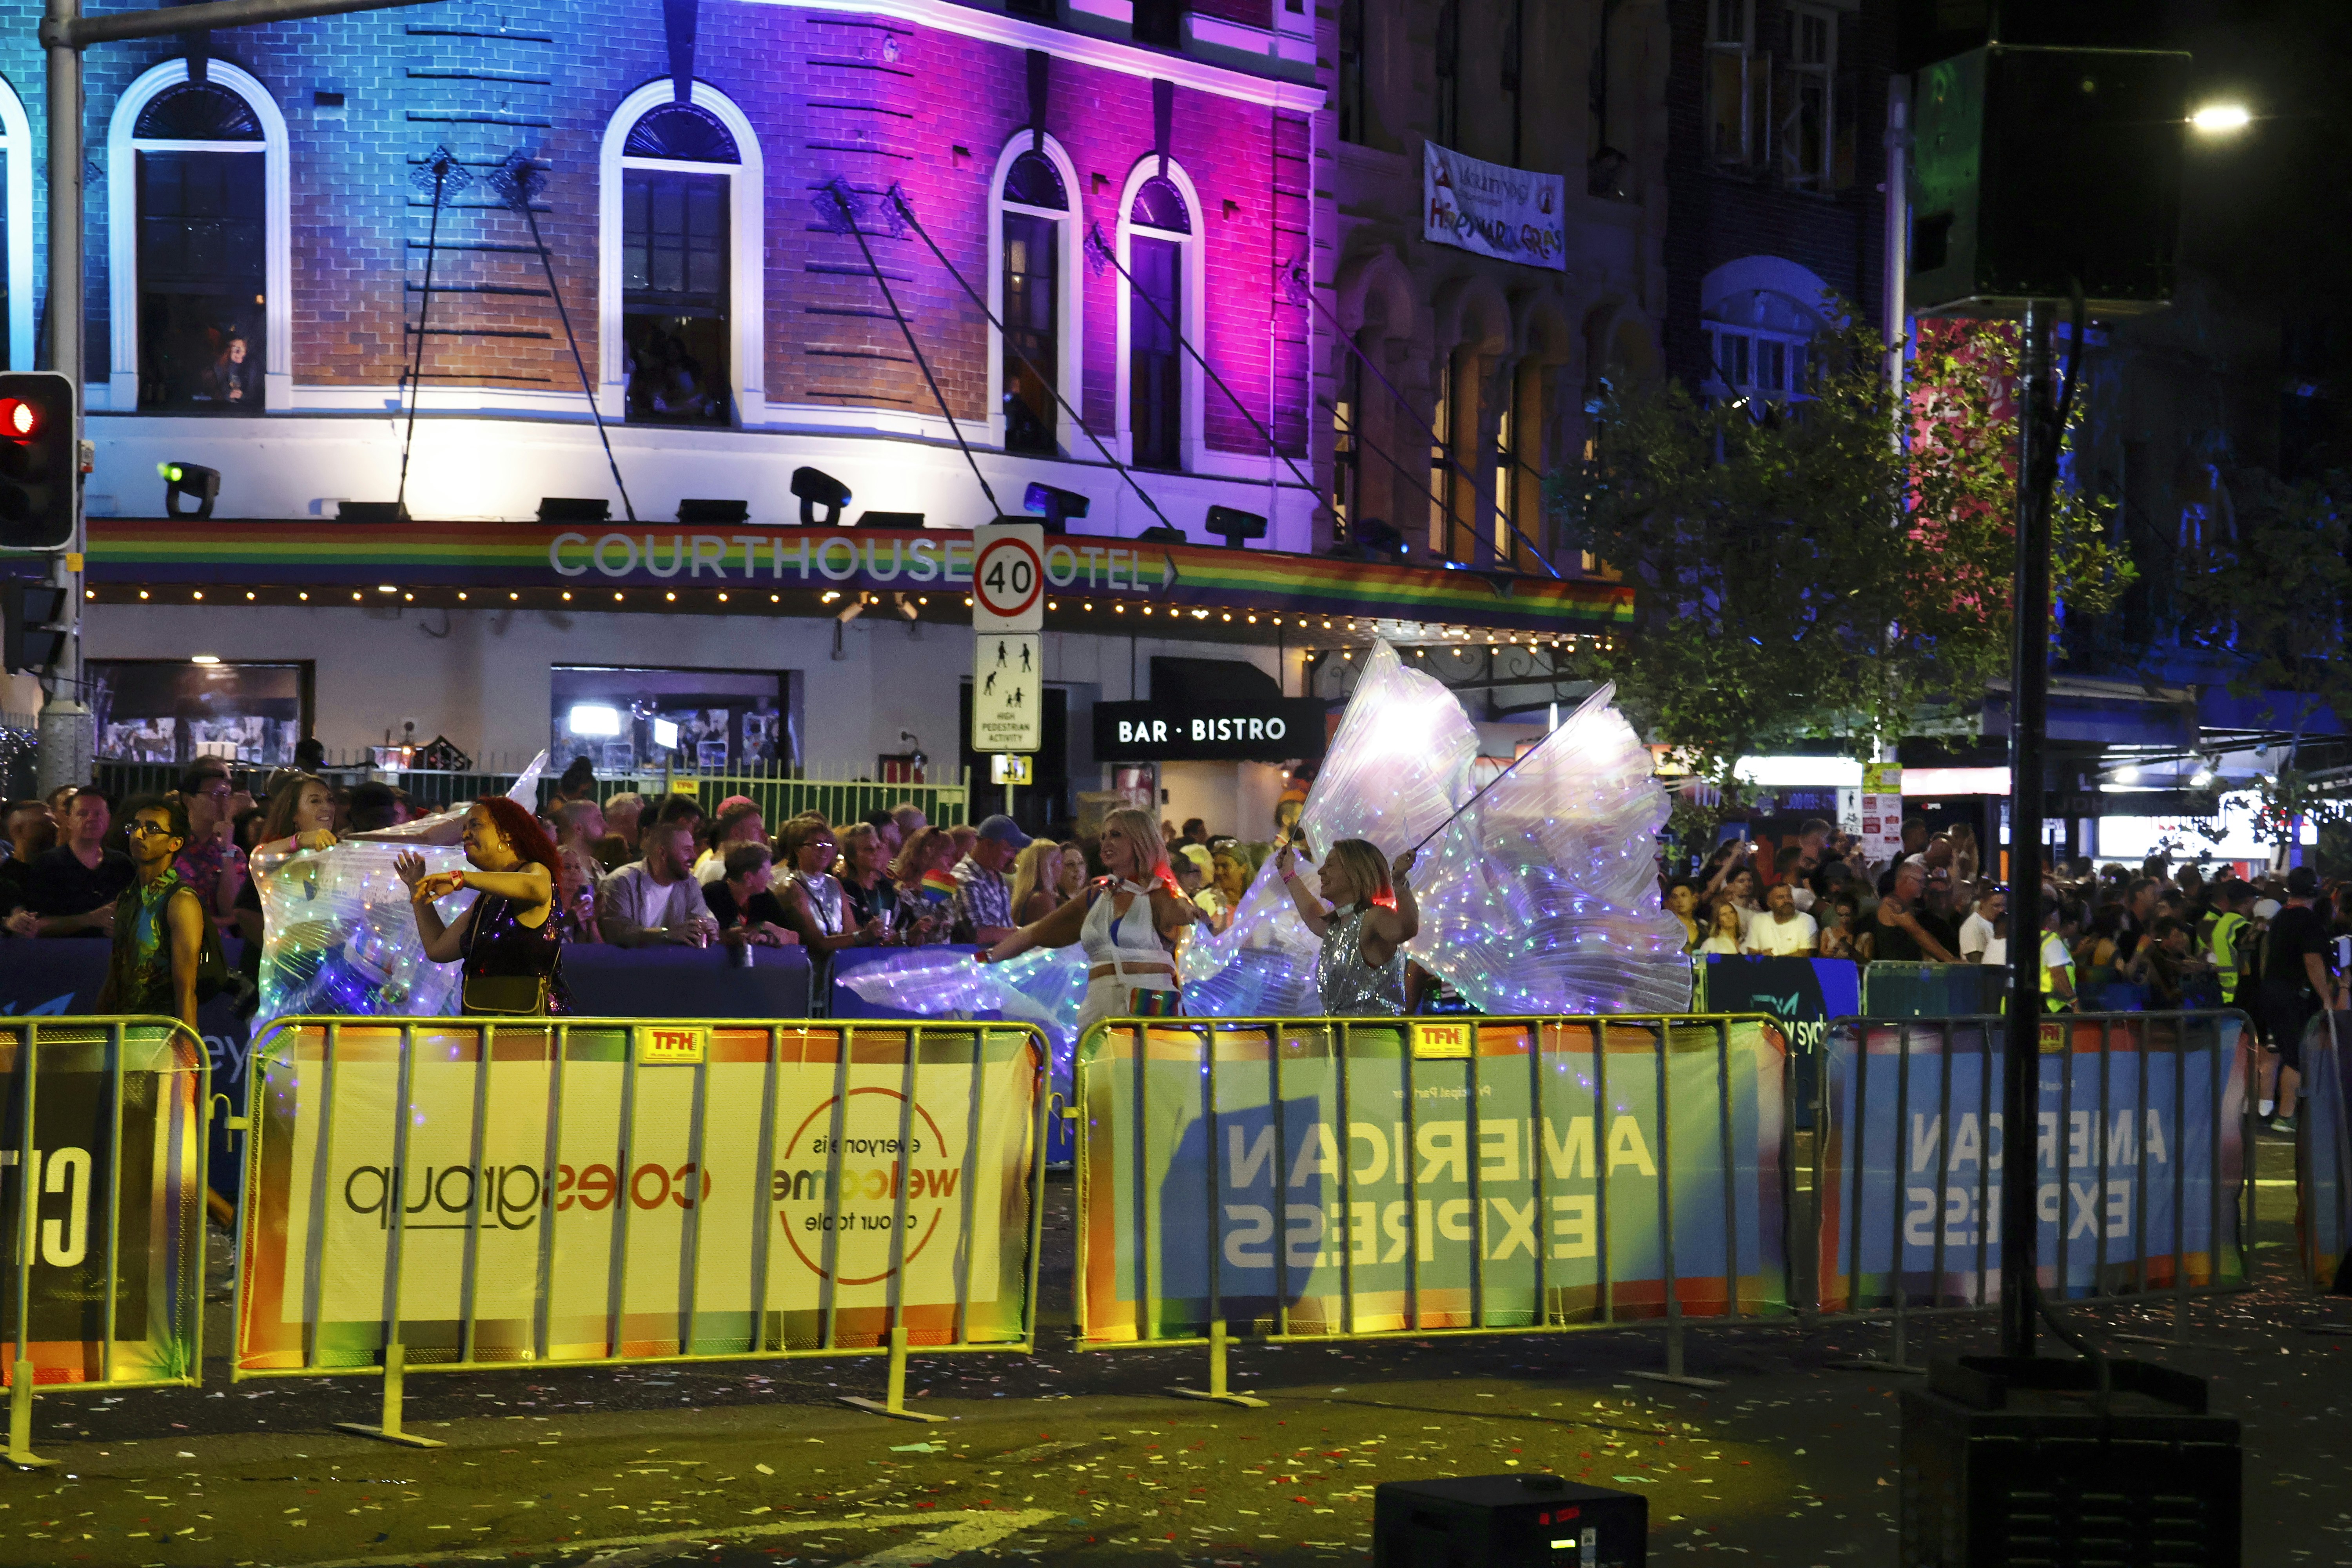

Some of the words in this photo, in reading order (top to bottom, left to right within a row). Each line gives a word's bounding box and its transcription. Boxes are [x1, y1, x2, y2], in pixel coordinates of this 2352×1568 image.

[549, 532, 973, 582] COURTHOUSE
[1045, 544, 1149, 592] OTEL
[985, 561, 1031, 593] 40
[982, 723, 1030, 731] PEDESTRIAN
[1118, 720, 1167, 742] BAR
[1192, 717, 1286, 740] BISTRO
[989, 734, 1022, 742] ACTIVITY
[653, 1031, 694, 1050] TFH
[1422, 1028, 1460, 1044] TFH
